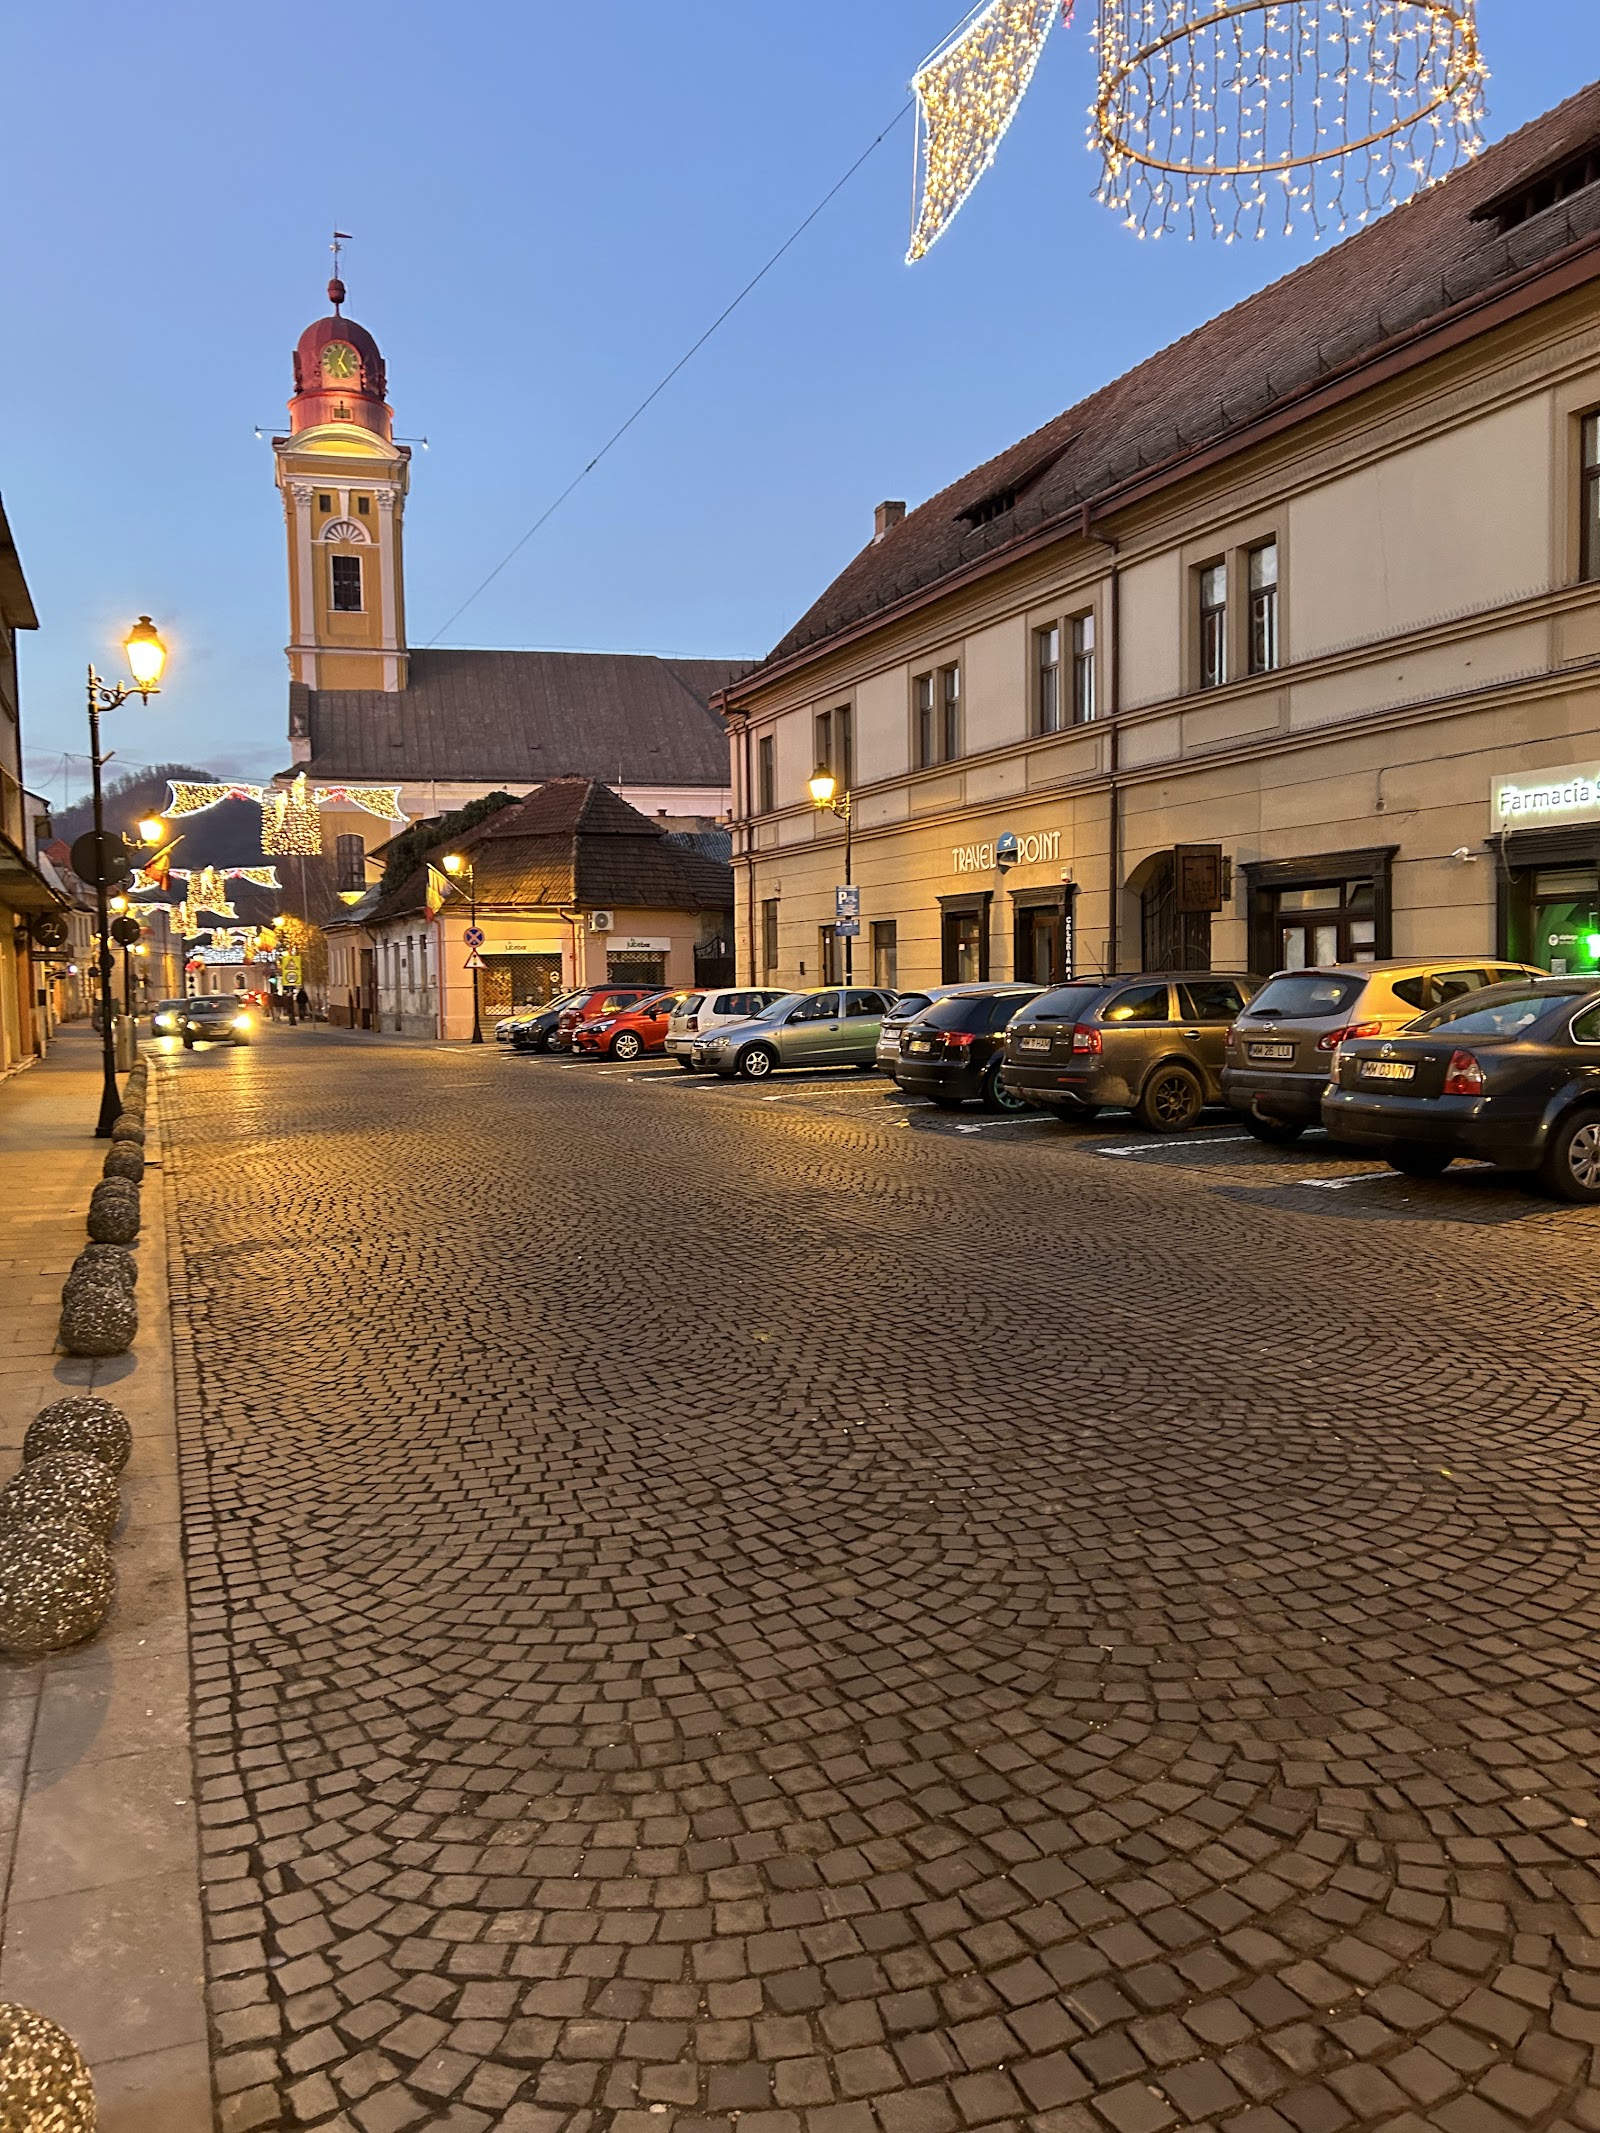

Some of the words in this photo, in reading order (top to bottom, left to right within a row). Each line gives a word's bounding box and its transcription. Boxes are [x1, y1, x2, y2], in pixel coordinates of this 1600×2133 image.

[1500, 782, 1589, 812] Farmacia
[952, 843, 997, 873] TRAVEL
[1017, 830, 1062, 864] POINT
[838, 891, 848, 905] P
[1265, 1046, 1274, 1056] 26
